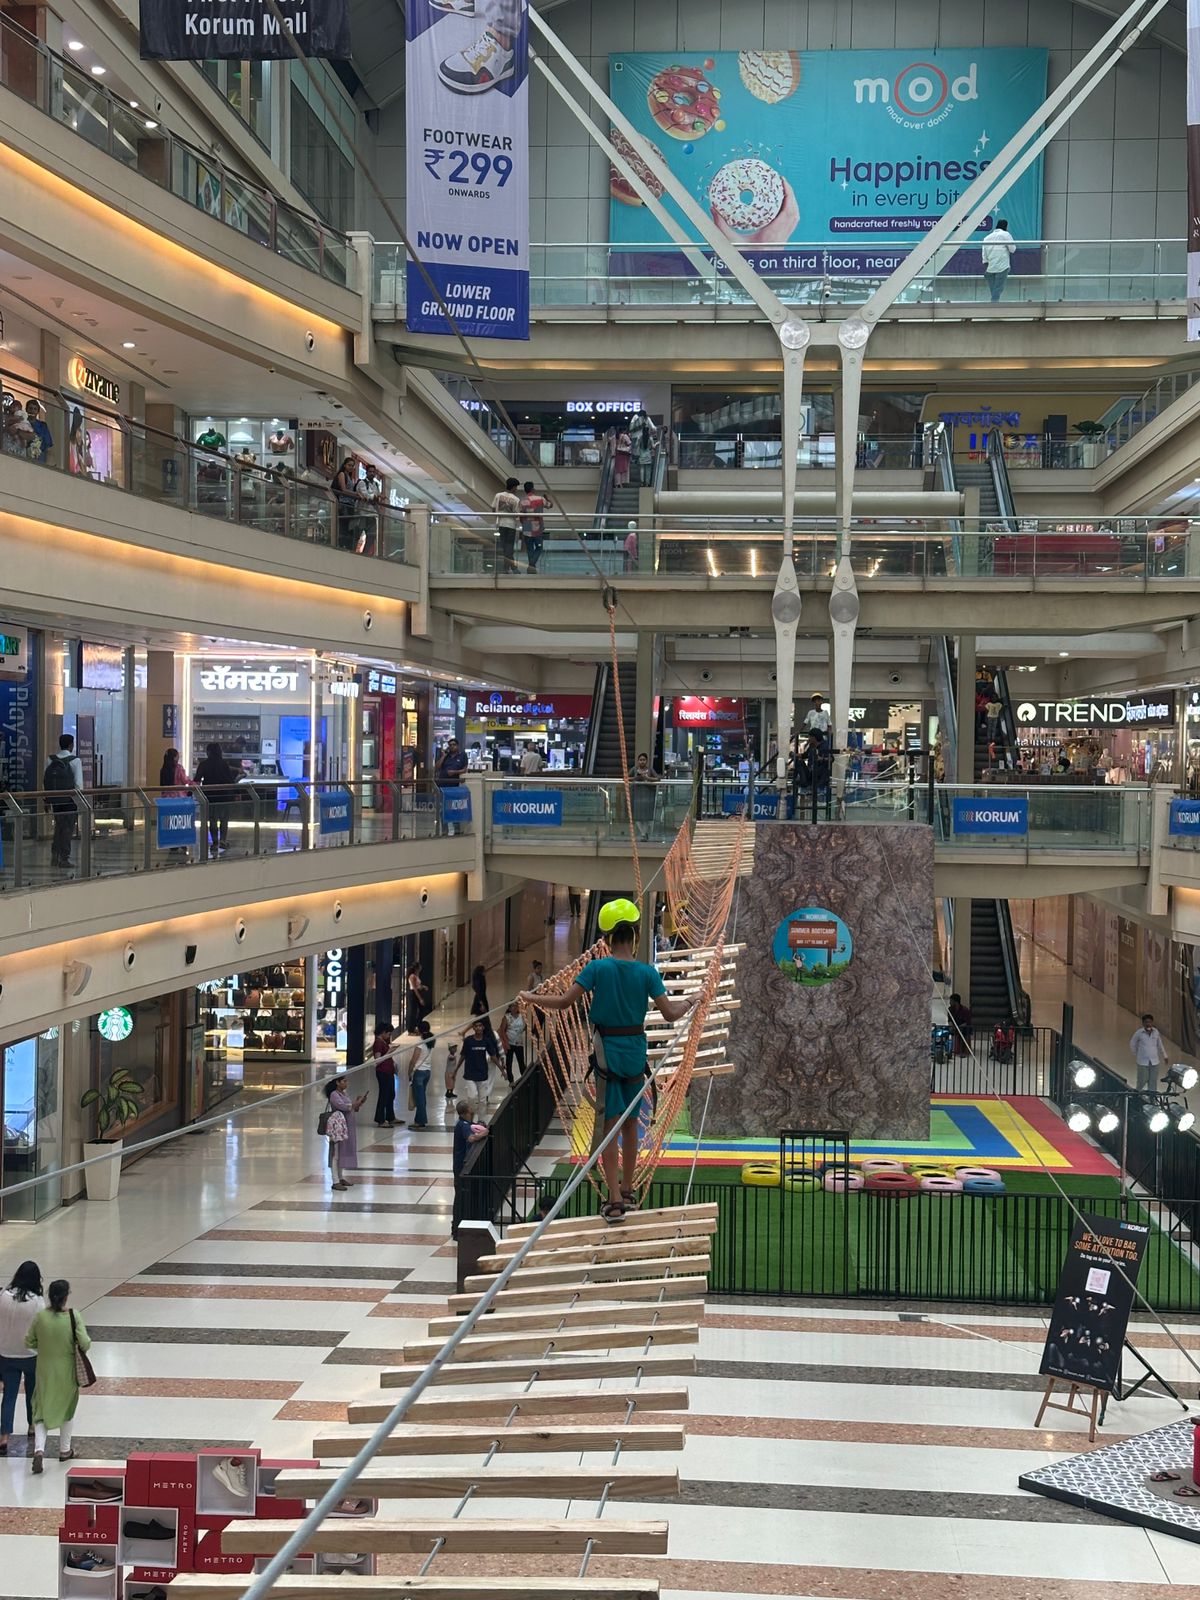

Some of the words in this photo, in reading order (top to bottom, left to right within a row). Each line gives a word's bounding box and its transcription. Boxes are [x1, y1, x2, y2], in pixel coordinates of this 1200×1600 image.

[185, 13, 255, 36] Korum
[263, 11, 308, 36] Mall
[854, 62, 978, 104] mod
[886, 105, 903, 124] mad
[904, 121, 925, 130] over
[927, 103, 954, 128] donuts
[423, 128, 513, 151] FOOTWEAR
[448, 188, 491, 199] ONWARDS
[852, 190, 868, 206] in
[875, 192, 929, 210] every
[936, 188, 960, 206] bit
[834, 218, 889, 229] handcrafted
[891, 218, 921, 230] freshly
[417, 231, 463, 251] NOW
[468, 235, 519, 256] OPEN
[760, 258, 778, 269] on
[782, 255, 817, 269] third
[821, 255, 861, 271] floor,
[865, 257, 901, 269] near
[446, 283, 491, 300] LOWER
[421, 301, 473, 319] GROUND
[476, 305, 516, 322] FLOOR
[566, 401, 593, 413] BOX
[596, 401, 642, 413] OFFICE
[475, 700, 522, 714] Reliance
[523, 702, 555, 716] digital
[3, 686, 29, 793] PlayStatio
[328, 804, 348, 819] KORUM
[513, 802, 555, 815] KORUM
[752, 803, 777, 817] ORU
[168, 814, 192, 831] KORUM
[975, 810, 1020, 823] KORUM
[1178, 811, 1200, 824] KORUM
[1127, 1224, 1148, 1233] KORUM
[1074, 1240, 1091, 1251] SOME
[1114, 1238, 1123, 1248] TO
[1123, 1240, 1137, 1250] BAG
[153, 1482, 193, 1490] METRO
[204, 1556, 243, 1564] METRO
